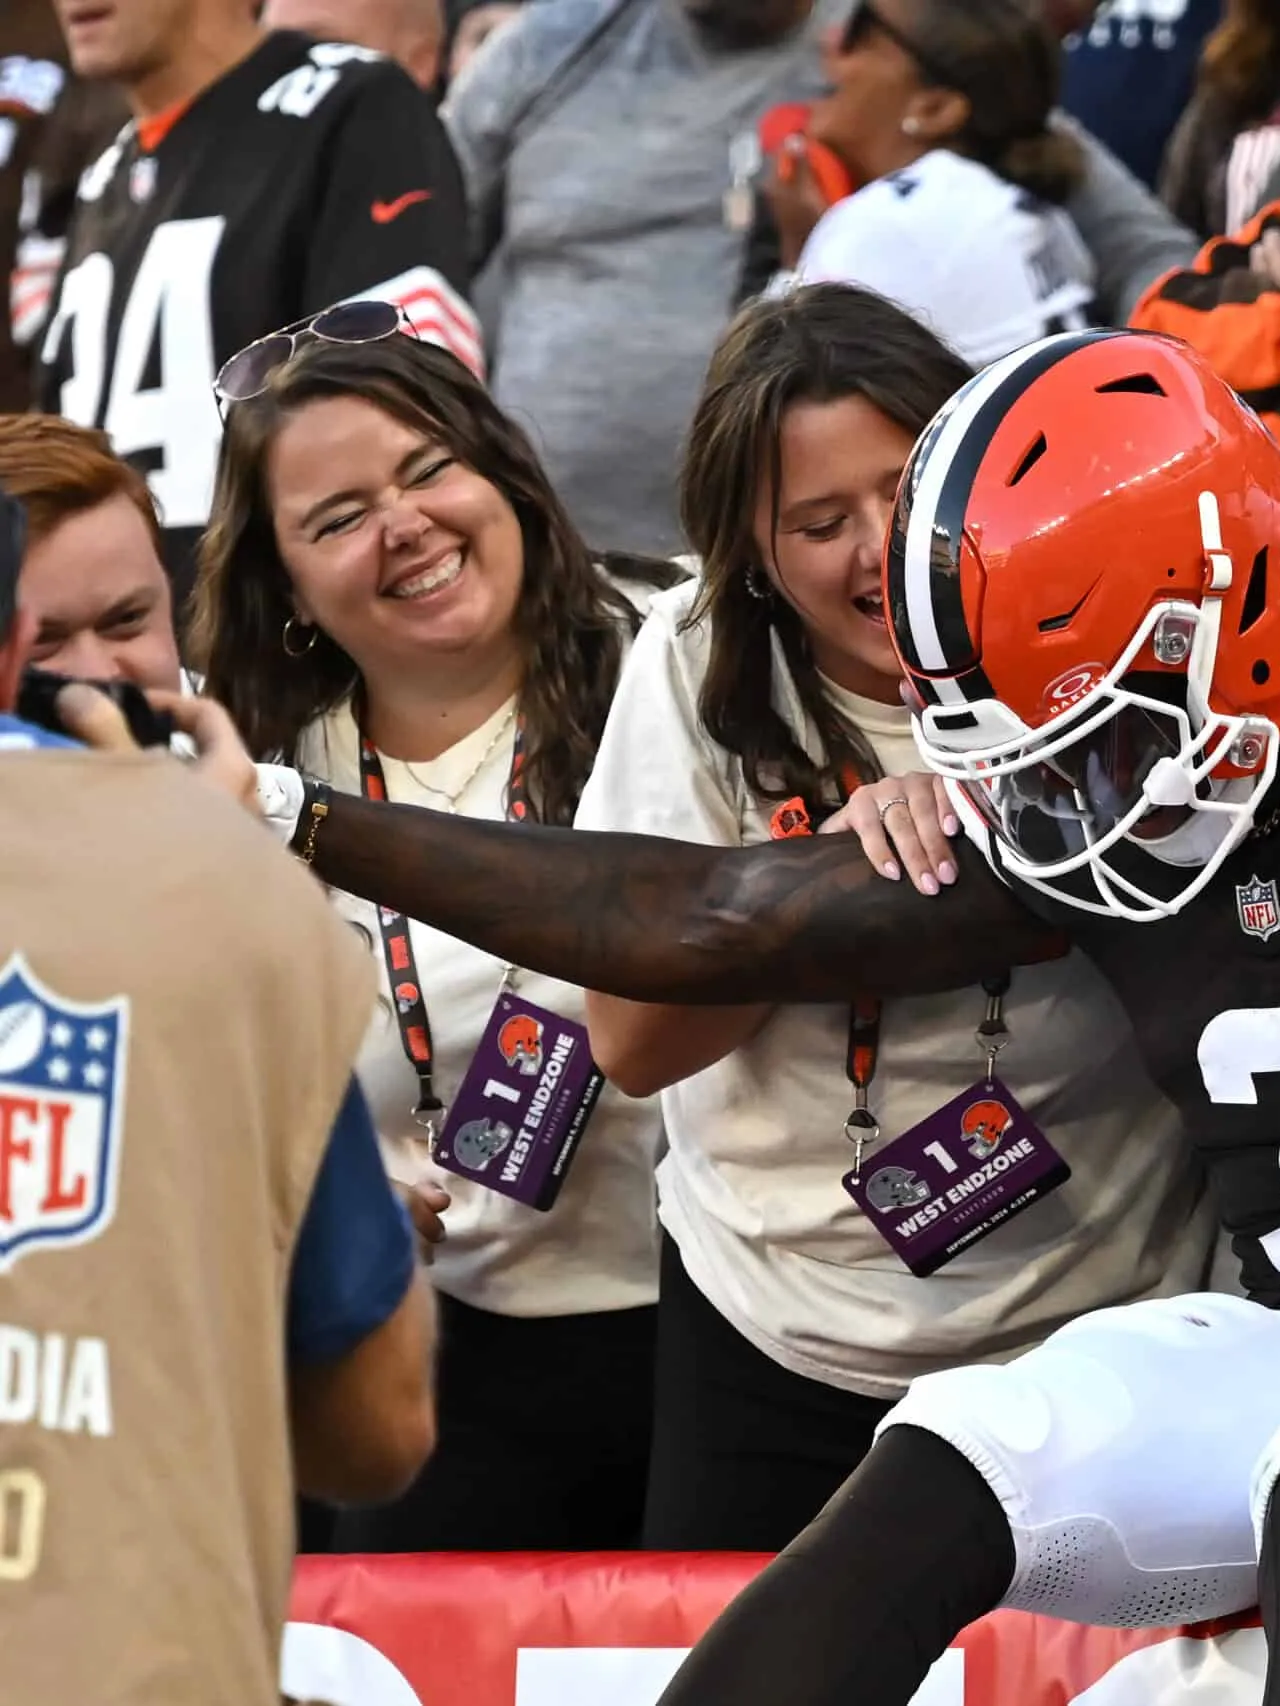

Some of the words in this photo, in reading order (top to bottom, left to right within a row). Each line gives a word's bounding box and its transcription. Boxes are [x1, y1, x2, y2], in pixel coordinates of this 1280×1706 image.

[1244, 903, 1276, 929] NFL
[483, 1078, 521, 1104] 1
[500, 1128, 534, 1182] WEST
[523, 1032, 576, 1129] ENDZONE
[923, 1139, 960, 1174] 1
[895, 1196, 949, 1239] WEST
[945, 1136, 1036, 1205] ENDZONE
